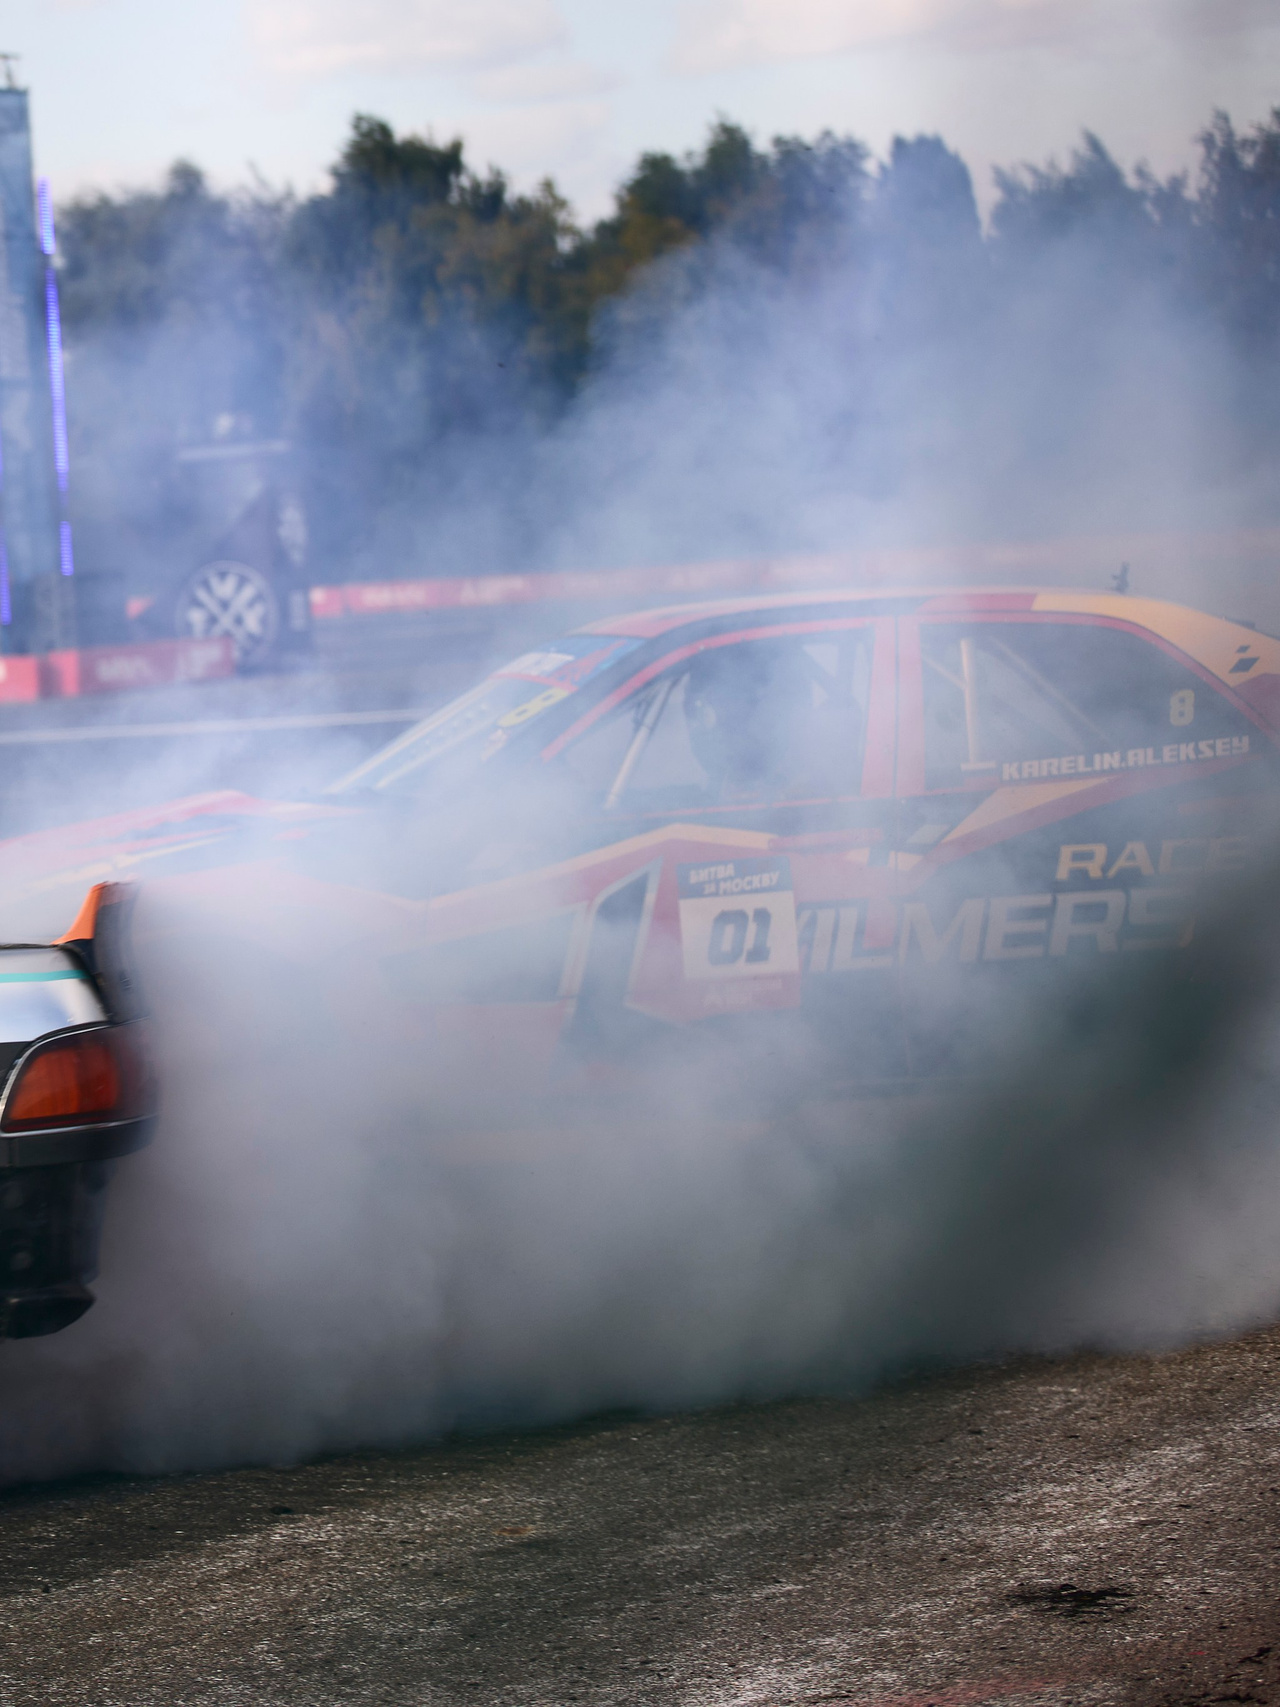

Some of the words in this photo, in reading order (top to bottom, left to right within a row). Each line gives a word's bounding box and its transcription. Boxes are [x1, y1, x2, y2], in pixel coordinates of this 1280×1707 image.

[1170, 689, 1195, 727] 8
[689, 863, 735, 884] БИТВА
[719, 870, 780, 895] МОСКВУ
[708, 908, 772, 966] 01
[797, 887, 1198, 973] ILMERS
